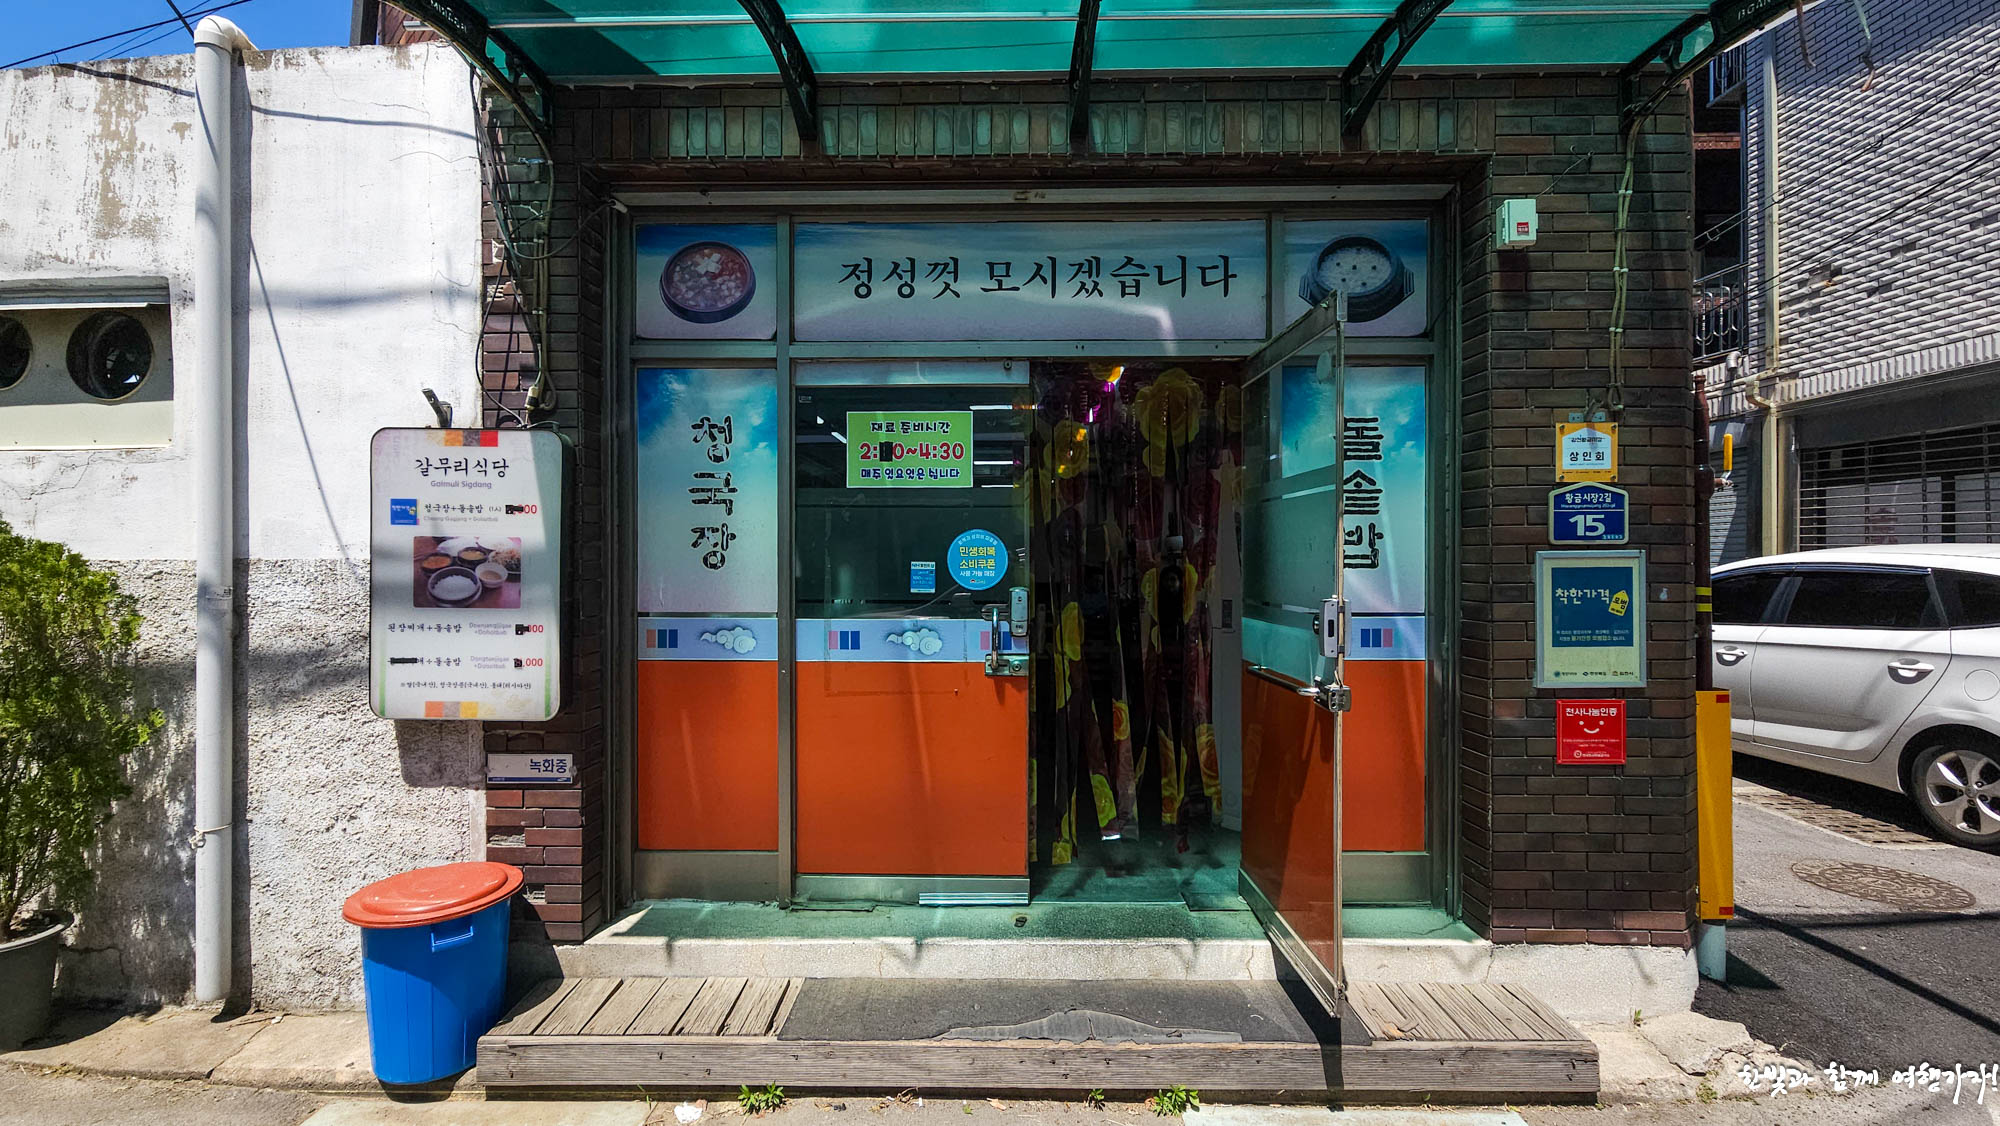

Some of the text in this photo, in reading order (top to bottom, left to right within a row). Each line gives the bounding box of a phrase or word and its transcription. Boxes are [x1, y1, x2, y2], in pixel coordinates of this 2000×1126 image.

[838, 254, 1237, 299] 정성껏 모시겠습니다
[870, 421, 951, 434] 재료 준비시간
[859, 442, 965, 460] 2:0~4:30
[415, 457, 509, 478] 갈무리식당
[861, 467, 960, 480] 매주 일요일은 쉽니다
[462, 481, 492, 489] Sigdang
[689, 415, 738, 569] 청국장
[1565, 492, 1612, 504] 황금시장2길
[1568, 514, 1606, 537] 15
[959, 546, 996, 557] 민생회복
[959, 558, 996, 569] 소비쿠폰
[1555, 587, 1610, 605] 착한가격
[1613, 596, 1628, 610] 모범
[1565, 707, 1618, 717] 천사나눔인증
[529, 758, 567, 774] 녹화중
